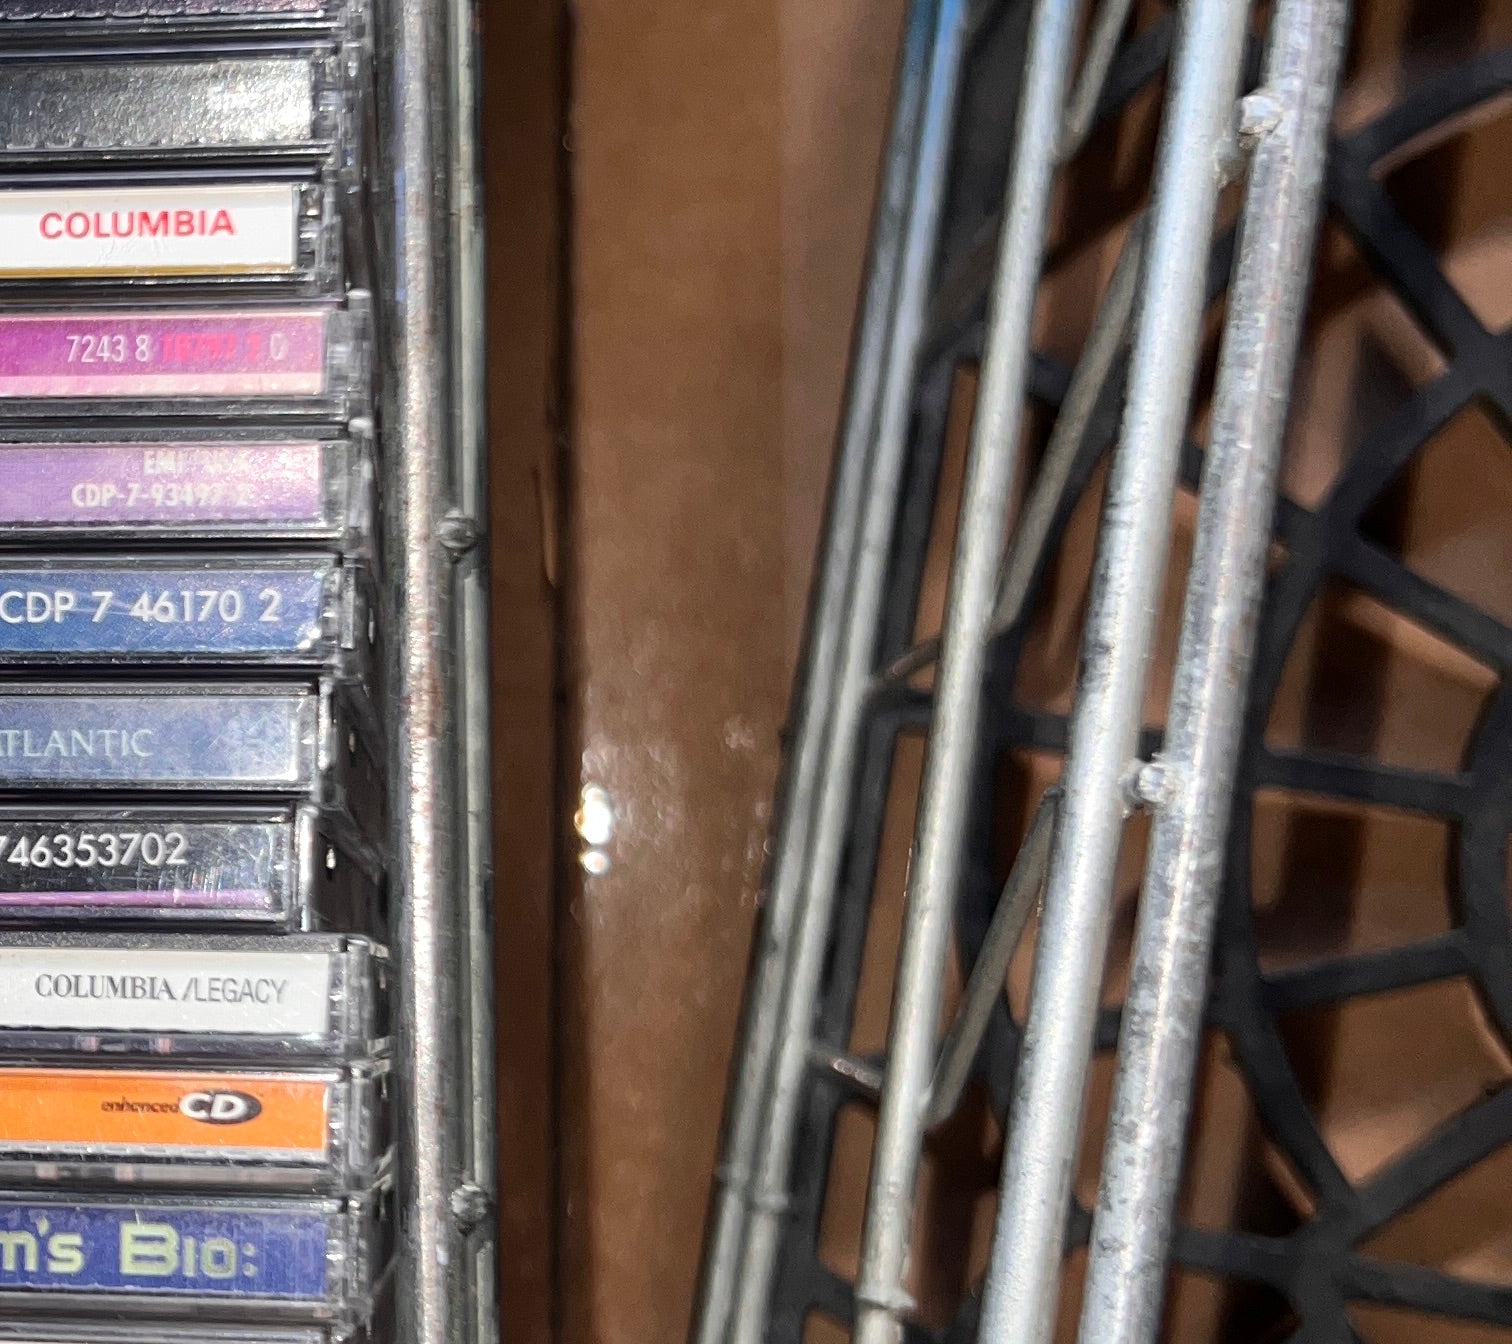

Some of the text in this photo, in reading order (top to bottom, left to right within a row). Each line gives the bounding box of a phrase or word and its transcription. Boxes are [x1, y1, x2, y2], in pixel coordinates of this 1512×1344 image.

[39, 210, 237, 240] COLUMBIA
[67, 335, 127, 364] 7243
[130, 590, 242, 623] 46170
[35, 972, 176, 1001] COLUMBIA
[101, 1097, 179, 1114] enhanced
